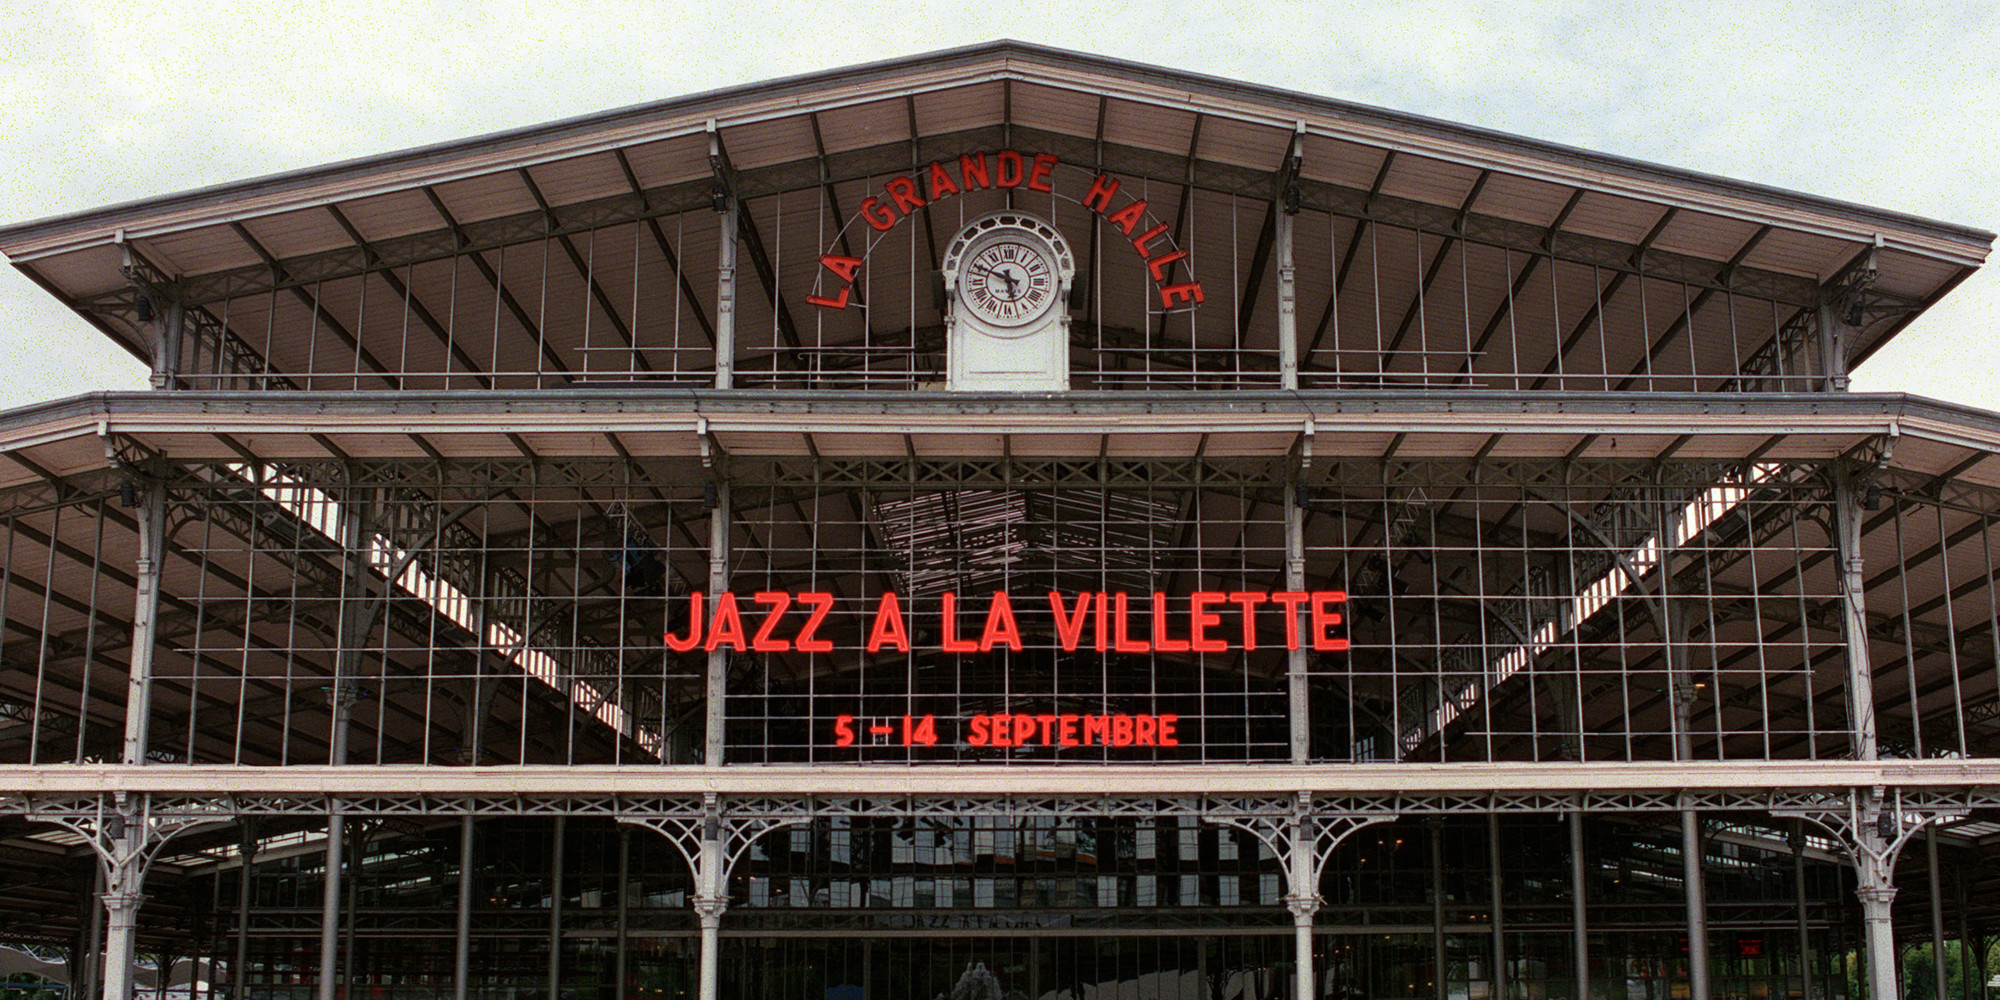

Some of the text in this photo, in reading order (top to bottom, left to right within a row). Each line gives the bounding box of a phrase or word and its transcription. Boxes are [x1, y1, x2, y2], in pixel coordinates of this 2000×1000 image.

[806, 150, 1206, 310] LA GRANDE HALLE
[663, 590, 1350, 653] JAZZ A LA VILLETTE
[834, 713, 856, 748] 5
[901, 713, 940, 748] 14
[967, 712, 1179, 748] SEPTEMBRE
